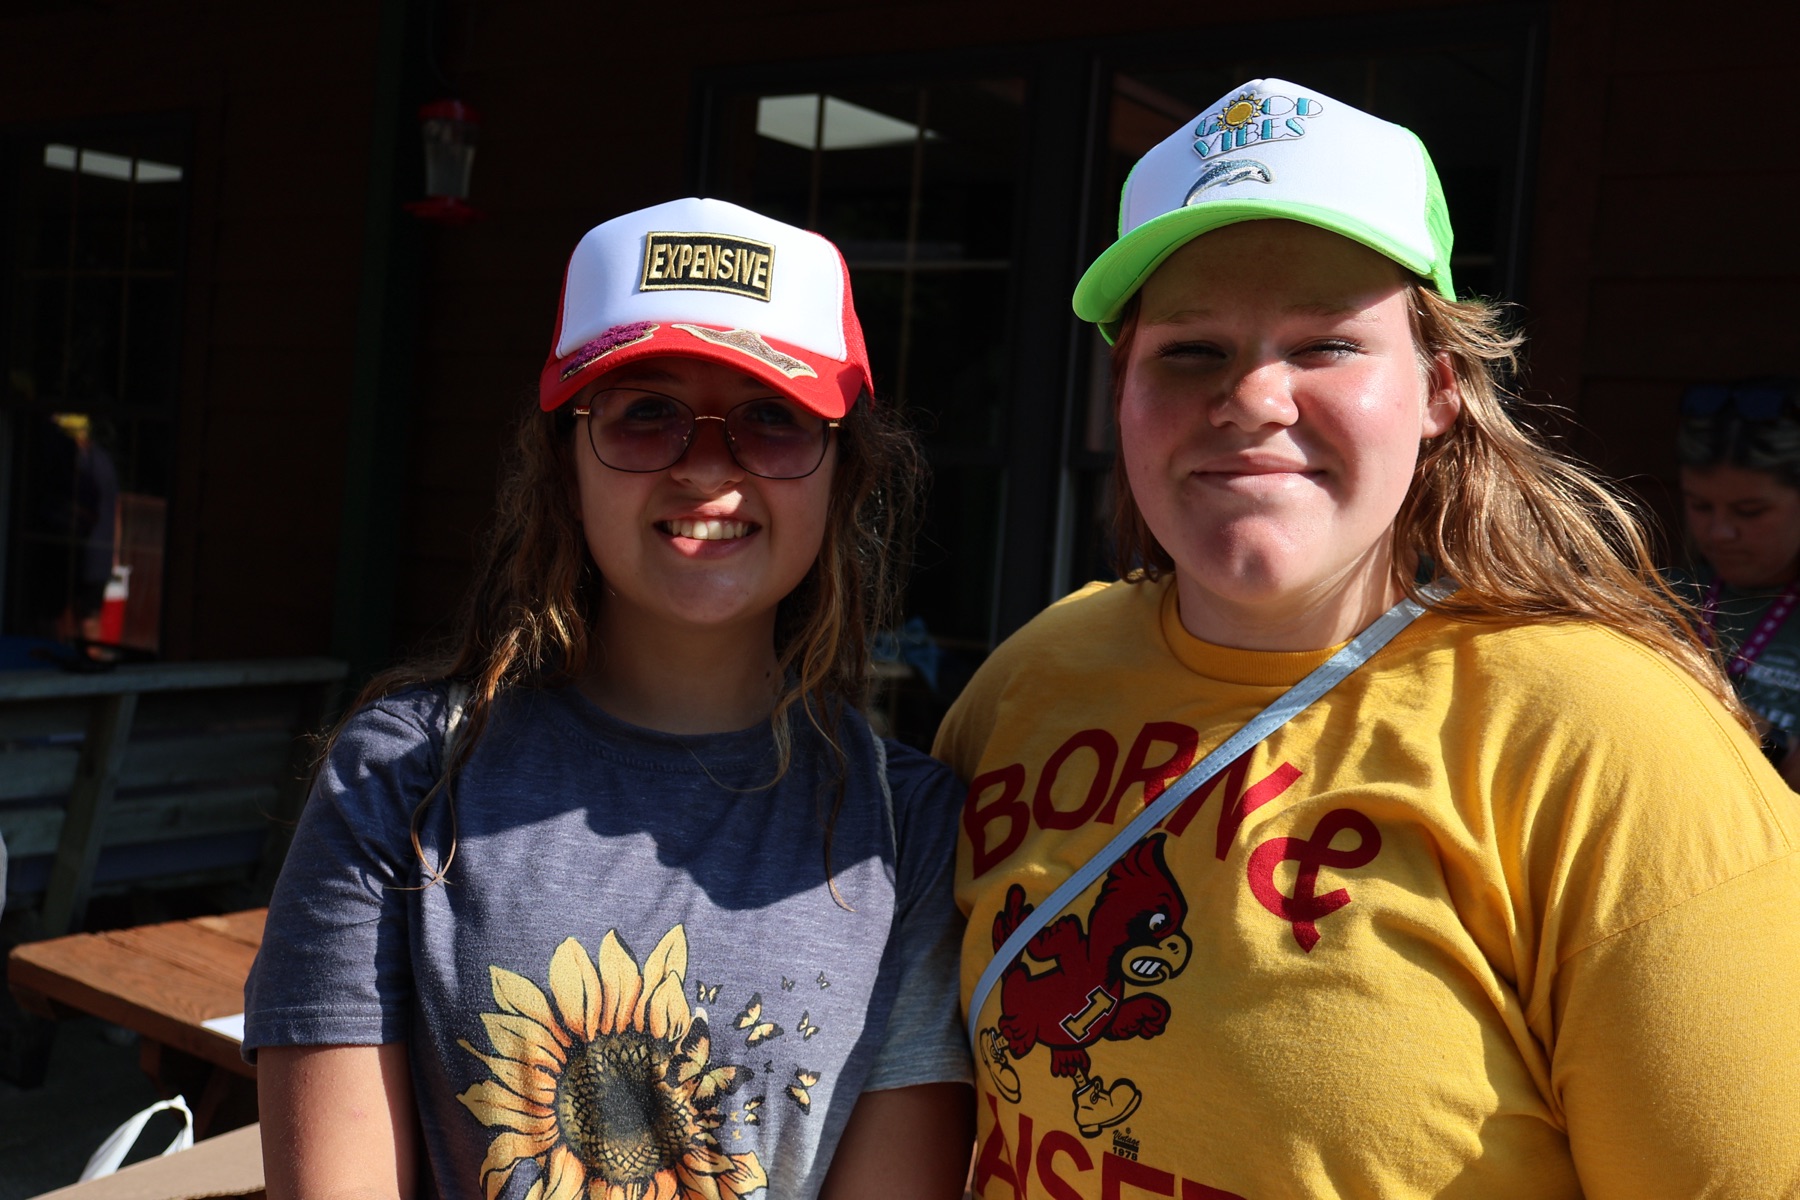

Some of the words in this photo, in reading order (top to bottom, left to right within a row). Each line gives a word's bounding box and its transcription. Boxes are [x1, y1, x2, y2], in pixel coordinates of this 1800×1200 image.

[1194, 117, 1305, 157] VIBES
[649, 243, 769, 289] EXPENSIVE
[964, 721, 1303, 880] BORN
[1112, 1146, 1139, 1162] 1978
